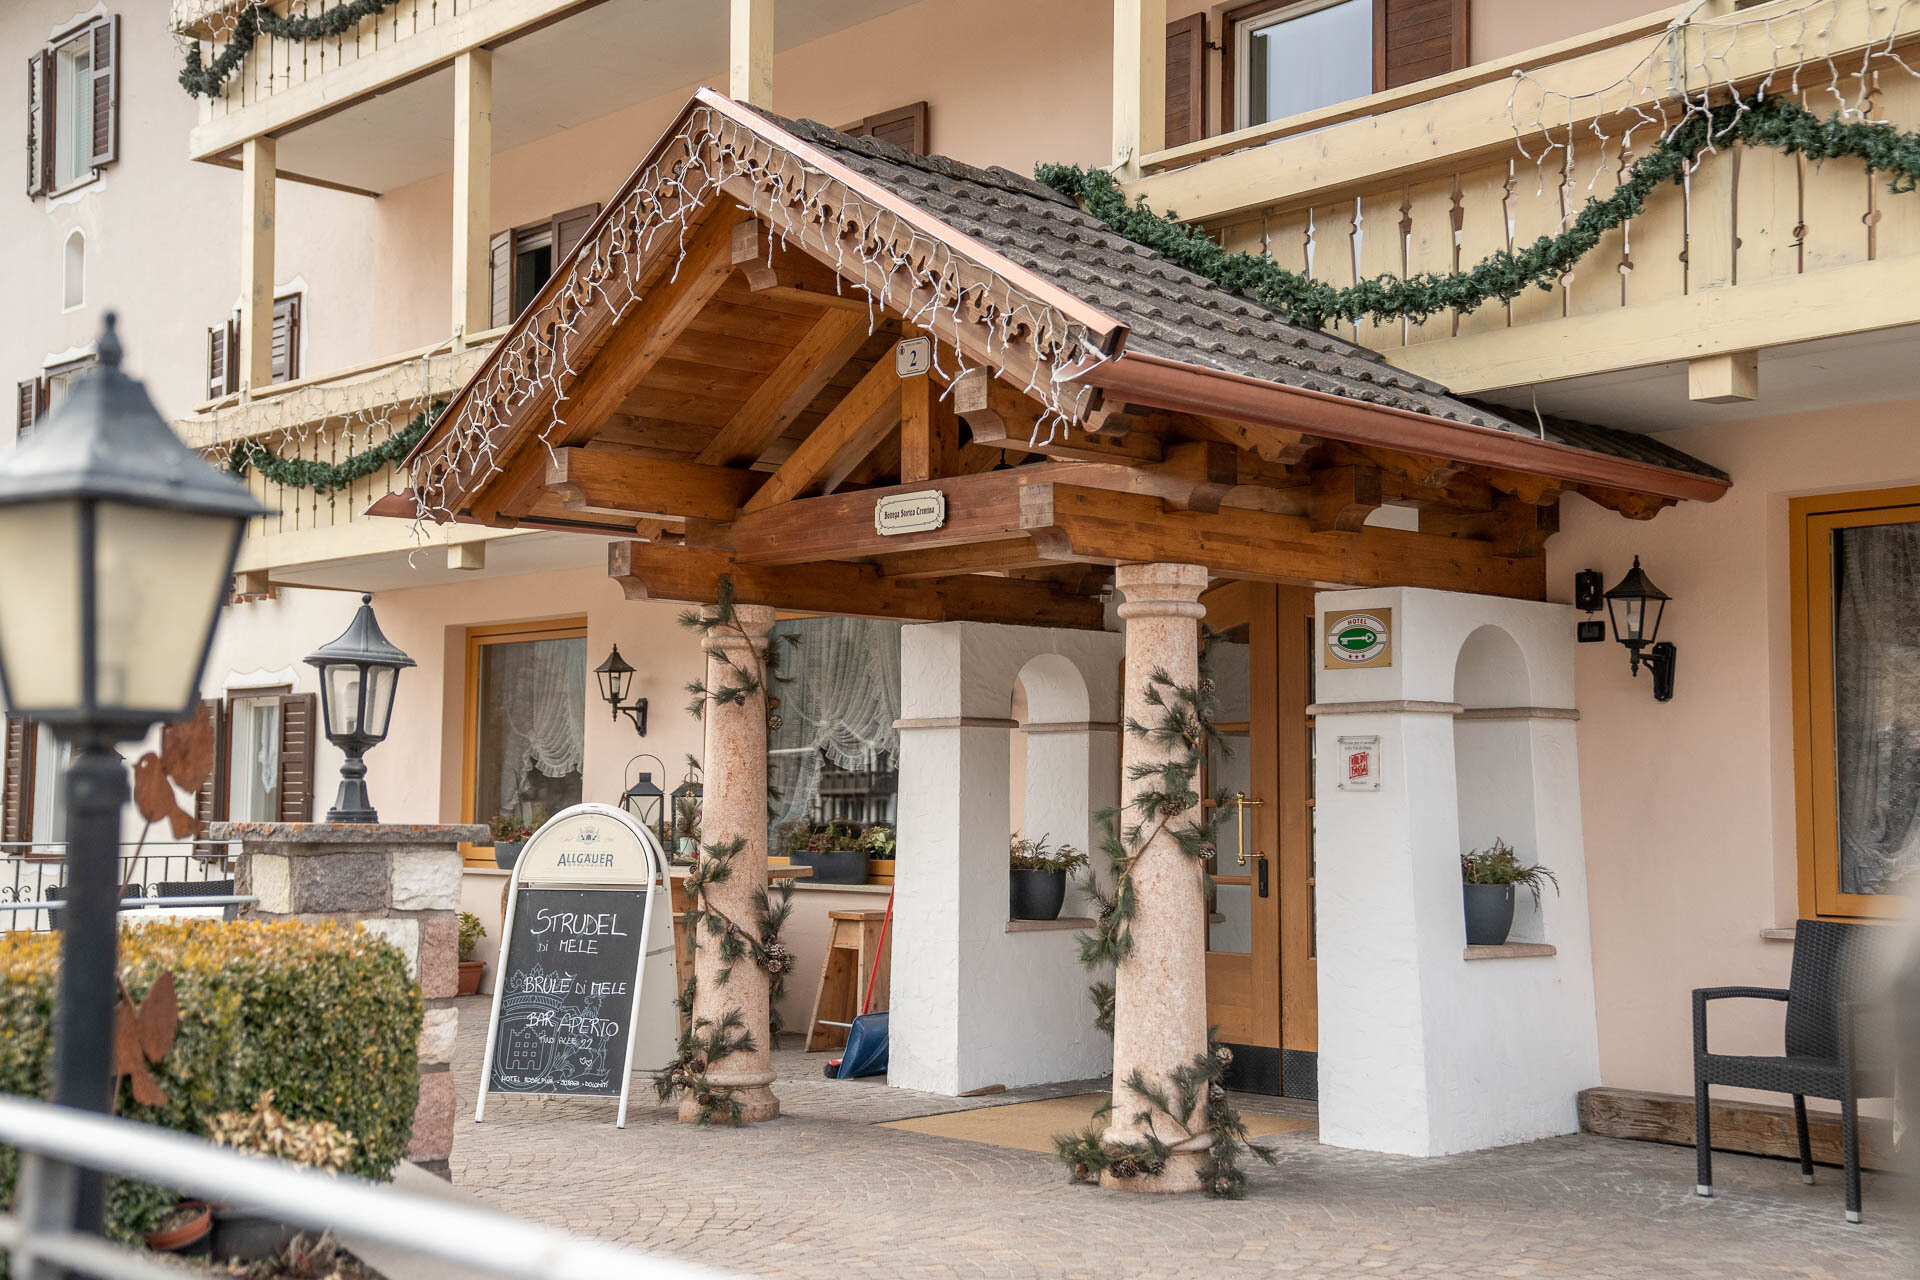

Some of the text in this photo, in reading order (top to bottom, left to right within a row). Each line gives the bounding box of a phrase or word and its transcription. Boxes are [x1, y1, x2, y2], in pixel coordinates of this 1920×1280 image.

[909, 349, 917, 368] 2
[900, 508, 915, 518] Storica
[530, 908, 628, 937] STRUDEL
[559, 939, 598, 954] MELE
[522, 971, 572, 994] BRULÈ
[591, 982, 627, 995] MELE
[525, 1010, 619, 1036] BAR APERTO
[579, 1039, 593, 1050] 22
[500, 1075, 521, 1083] HOTEL
